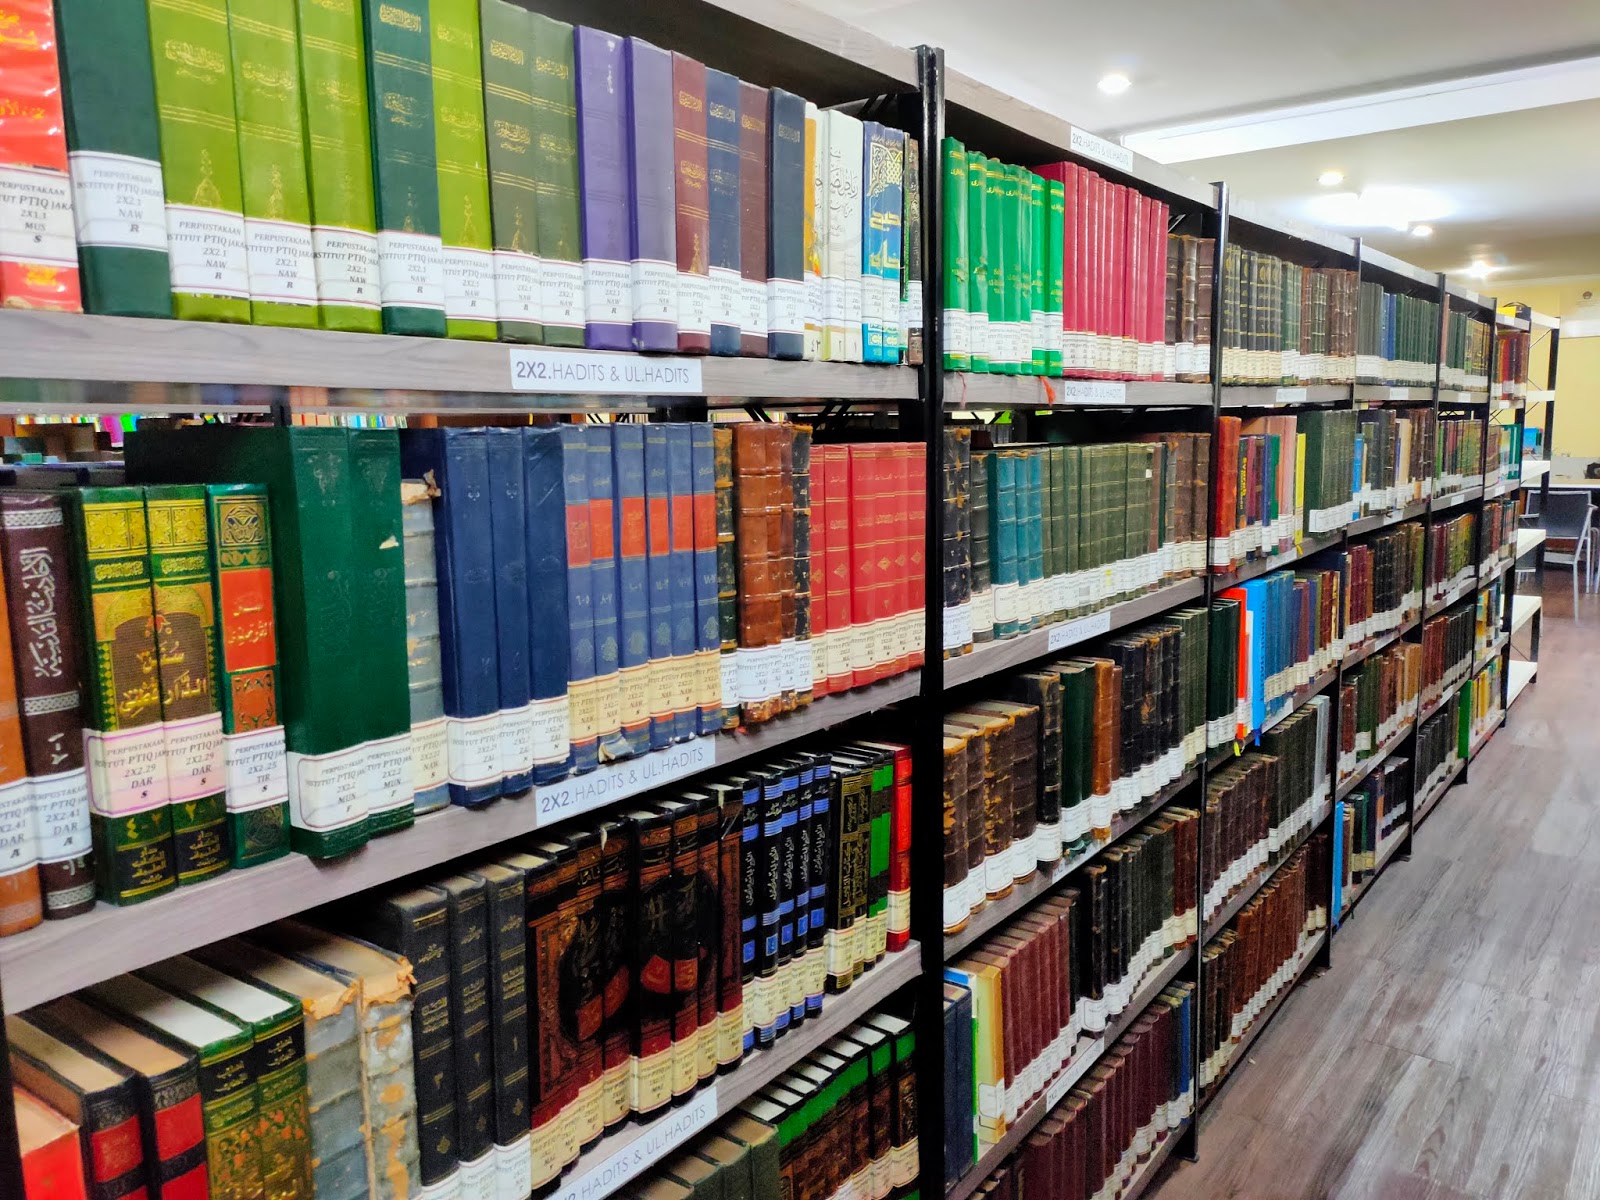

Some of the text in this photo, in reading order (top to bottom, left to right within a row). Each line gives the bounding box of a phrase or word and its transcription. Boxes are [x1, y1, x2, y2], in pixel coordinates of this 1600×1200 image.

[117, 182, 139, 195] PTIQ
[20, 195, 49, 209] PTIQ
[116, 195, 141, 206] 2X2.1
[119, 208, 143, 219] NAW
[25, 222, 46, 231] MUS
[130, 224, 140, 232] R
[179, 221, 241, 235] PERPUSTAKAAN
[33, 235, 42, 243] S
[203, 234, 226, 247] PTIQ
[254, 233, 310, 245] PERPUSTAKAAN
[203, 248, 226, 257] 2X2.1
[276, 246, 297, 257] PTIQ
[325, 240, 376, 254] PERPUSTAKAAN
[206, 259, 227, 269] NAW
[275, 257, 297, 267] 2X2.1
[347, 253, 367, 264] PTIQ
[408, 253, 426, 264] PTIQ
[278, 270, 297, 278] NAW
[346, 264, 366, 274] 2X2.1
[408, 264, 426, 273] 2X2.1
[462, 269, 479, 279] PTIQ
[350, 276, 367, 284] NAW
[411, 275, 426, 283] NAW
[287, 281, 293, 289] R
[416, 285, 424, 293] R
[464, 289, 480, 297] NAW
[516, 360, 690, 384] 2X2.HADITS & UL.HADITS
[190, 740, 212, 753] PTIQ
[128, 751, 153, 765] PTIQ
[186, 752, 214, 766] 2X2.29
[252, 751, 274, 763] PTIQ
[383, 758, 402, 768] PTIQ
[124, 763, 156, 778] 2X2.29
[192, 764, 212, 776] DAR
[200, 777, 207, 786] S
[337, 770, 356, 782] PTIQ
[542, 747, 704, 813] 2X2.HADITS & UL.HADITS
[131, 776, 153, 789] DAR
[50, 799, 76, 811] PTIQ
[53, 822, 78, 837] DAR
[633, 1149, 643, 1165] &
[646, 1104, 707, 1155] UL.HADITS
